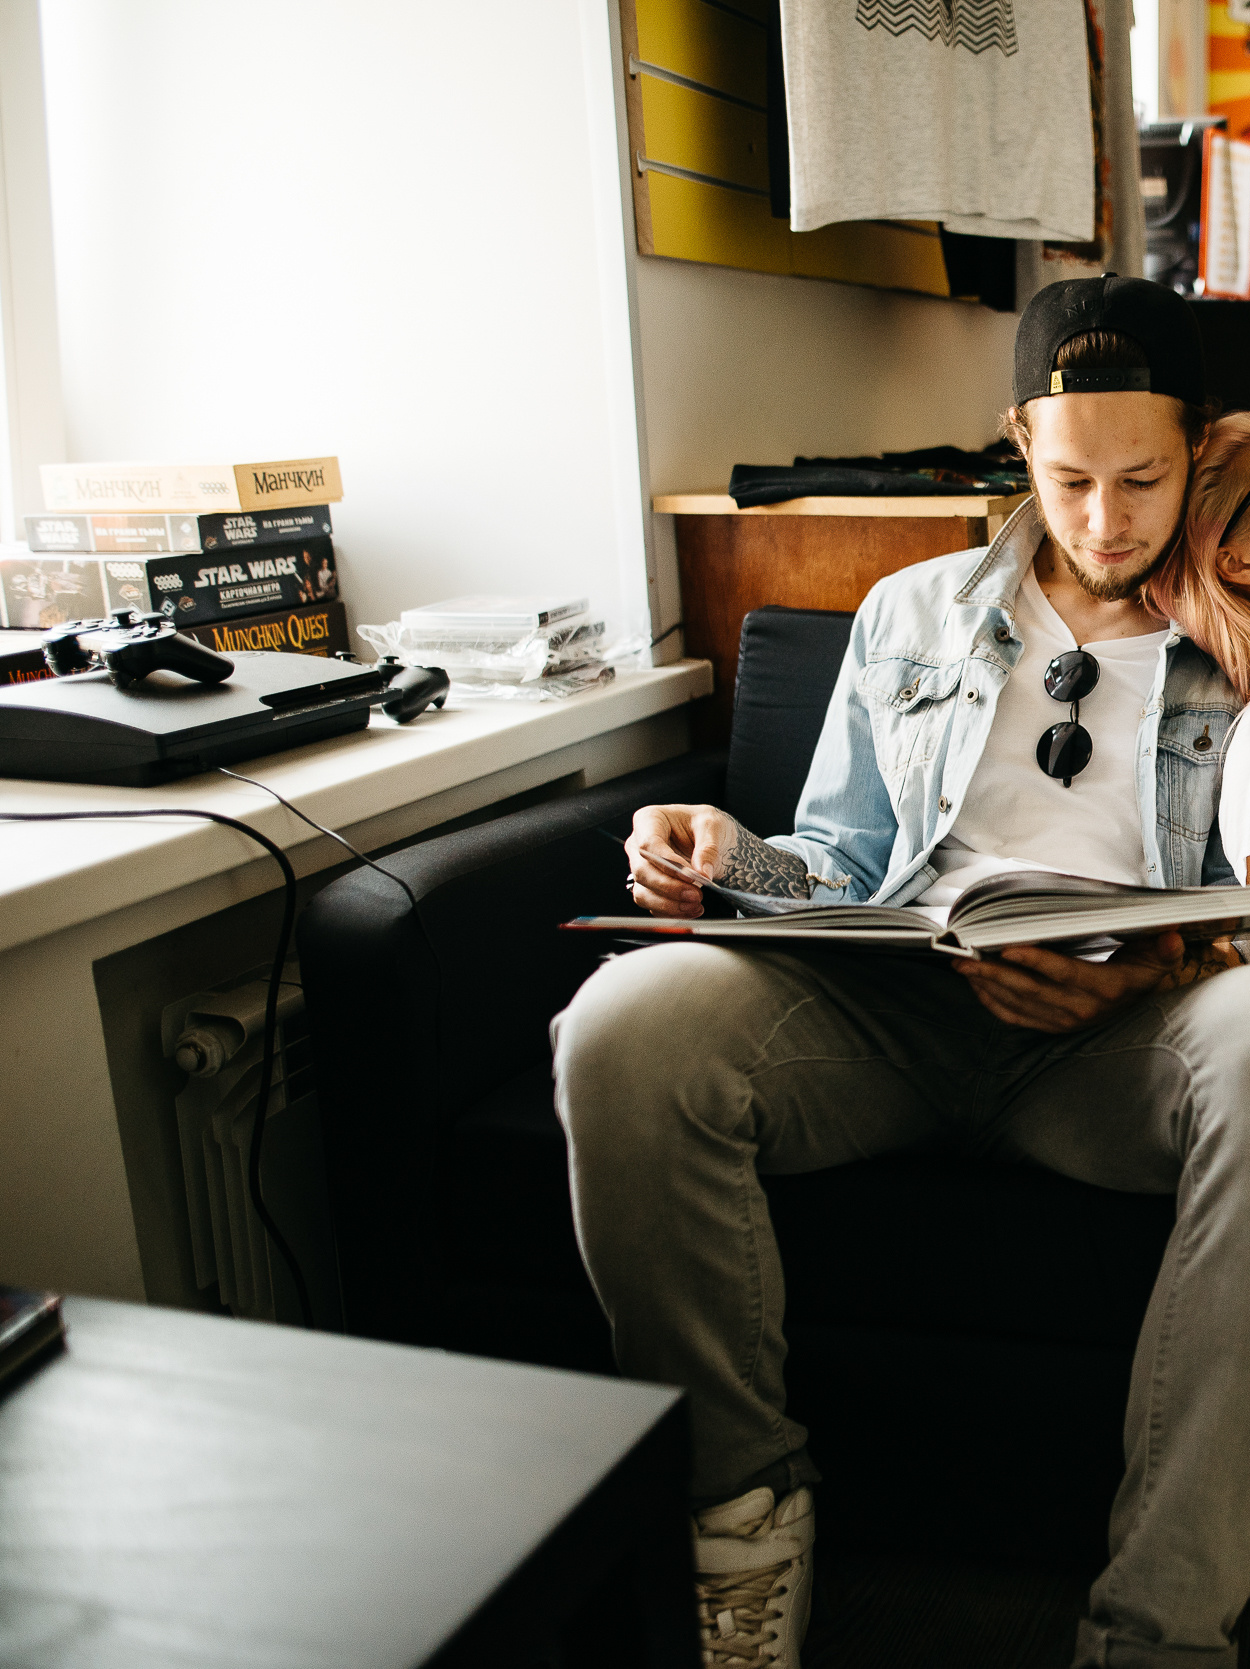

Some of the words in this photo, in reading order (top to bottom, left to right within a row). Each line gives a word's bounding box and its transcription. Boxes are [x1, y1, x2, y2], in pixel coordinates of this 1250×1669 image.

[252, 468, 325, 495] Манчкин
[75, 477, 163, 503] Манчкин
[35, 520, 79, 534] STAR
[222, 515, 257, 530] STAR
[37, 531, 80, 545] WARS
[224, 526, 259, 541] WARS
[194, 564, 248, 588] STAR
[248, 556, 297, 580] WARS
[219, 584, 263, 600] КАРТОЧНАЯ
[262, 582, 281, 593] ИГРА
